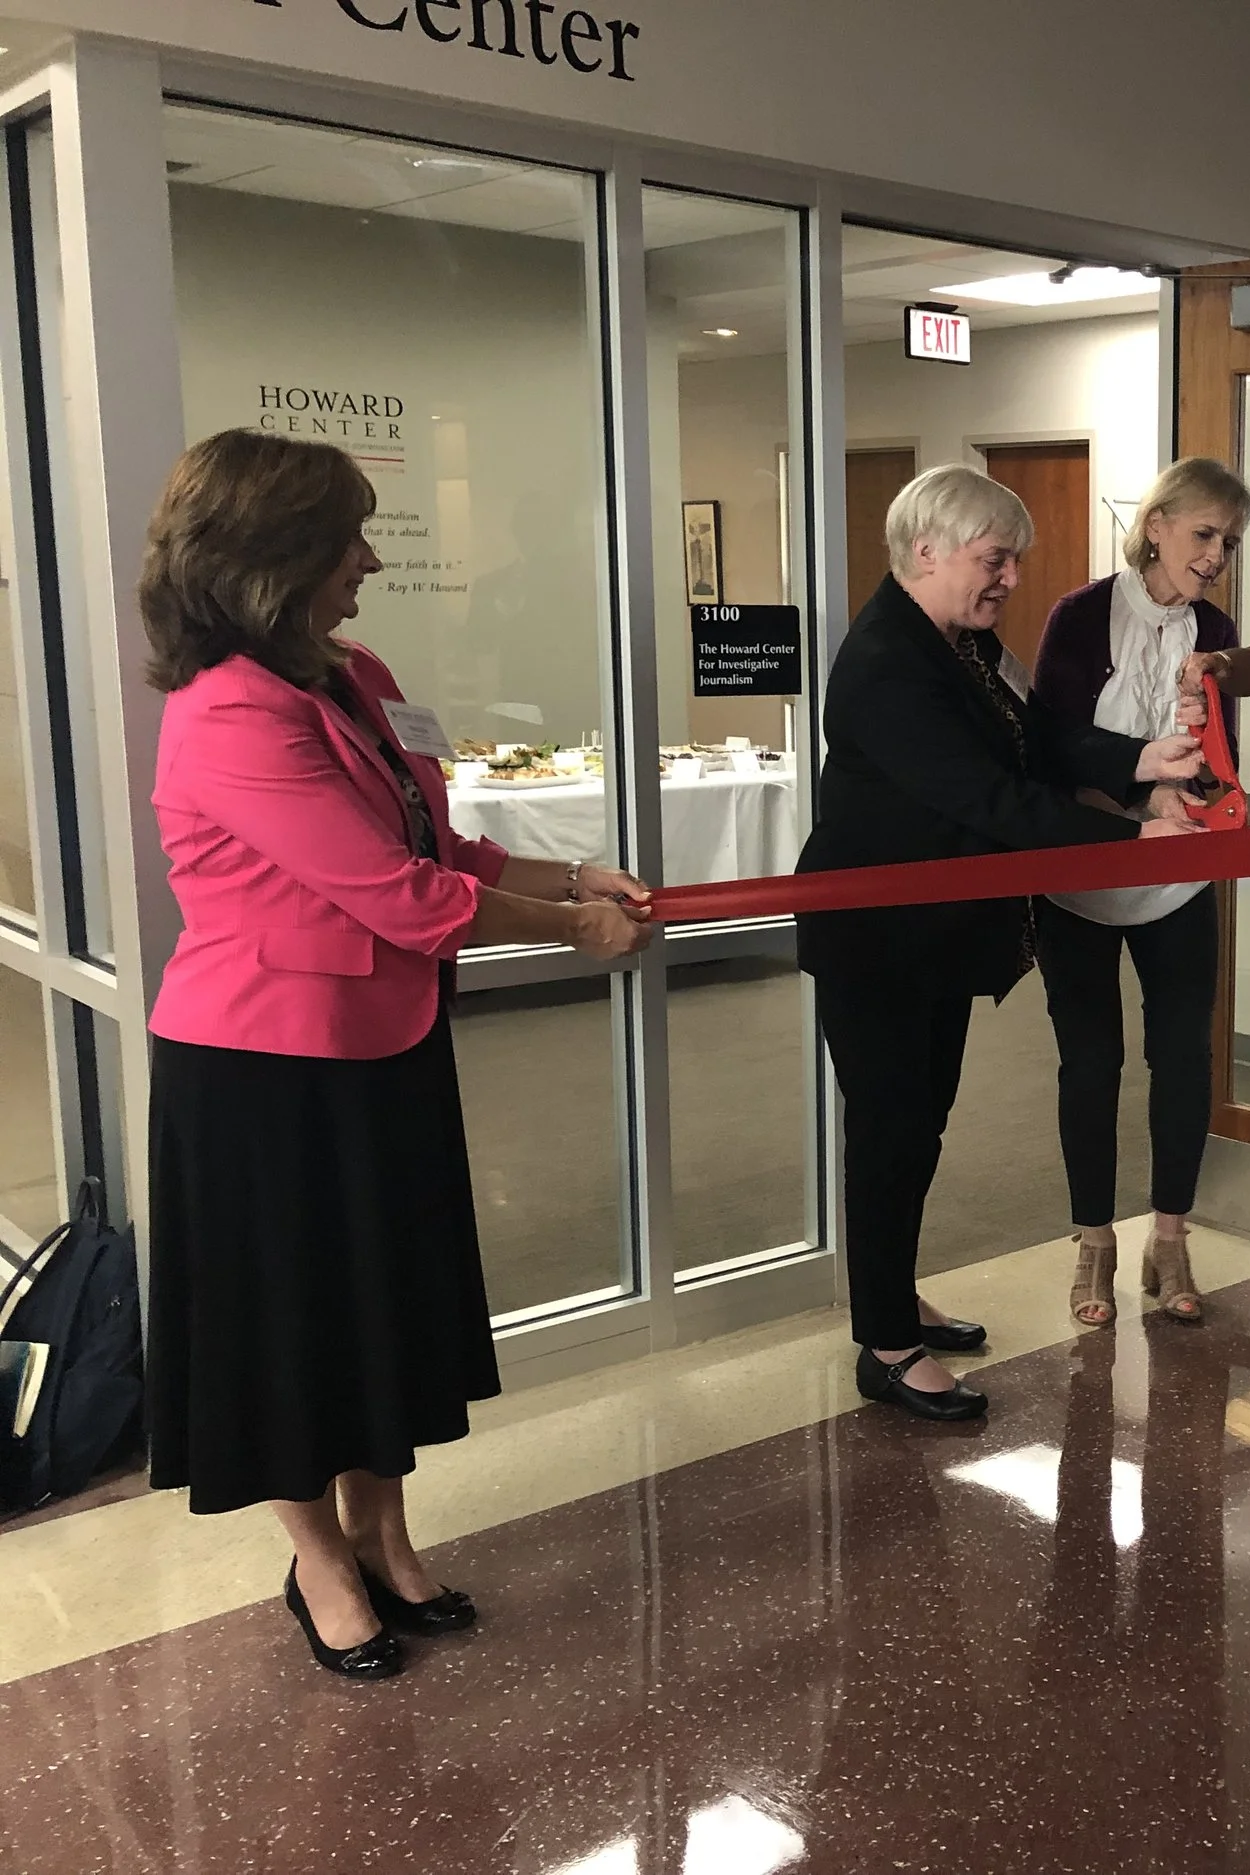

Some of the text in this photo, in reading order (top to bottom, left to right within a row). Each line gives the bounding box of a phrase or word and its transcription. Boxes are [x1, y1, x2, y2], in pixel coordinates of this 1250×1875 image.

[922, 315, 961, 355] EXIT
[259, 385, 404, 418] HOWARD
[260, 413, 402, 439] CENTER
[430, 581, 468, 593] Howard
[700, 606, 740, 622] 3100
[699, 643, 796, 655] The Howard Center
[698, 659, 779, 672] For Investigative
[700, 674, 753, 687] Journalism
